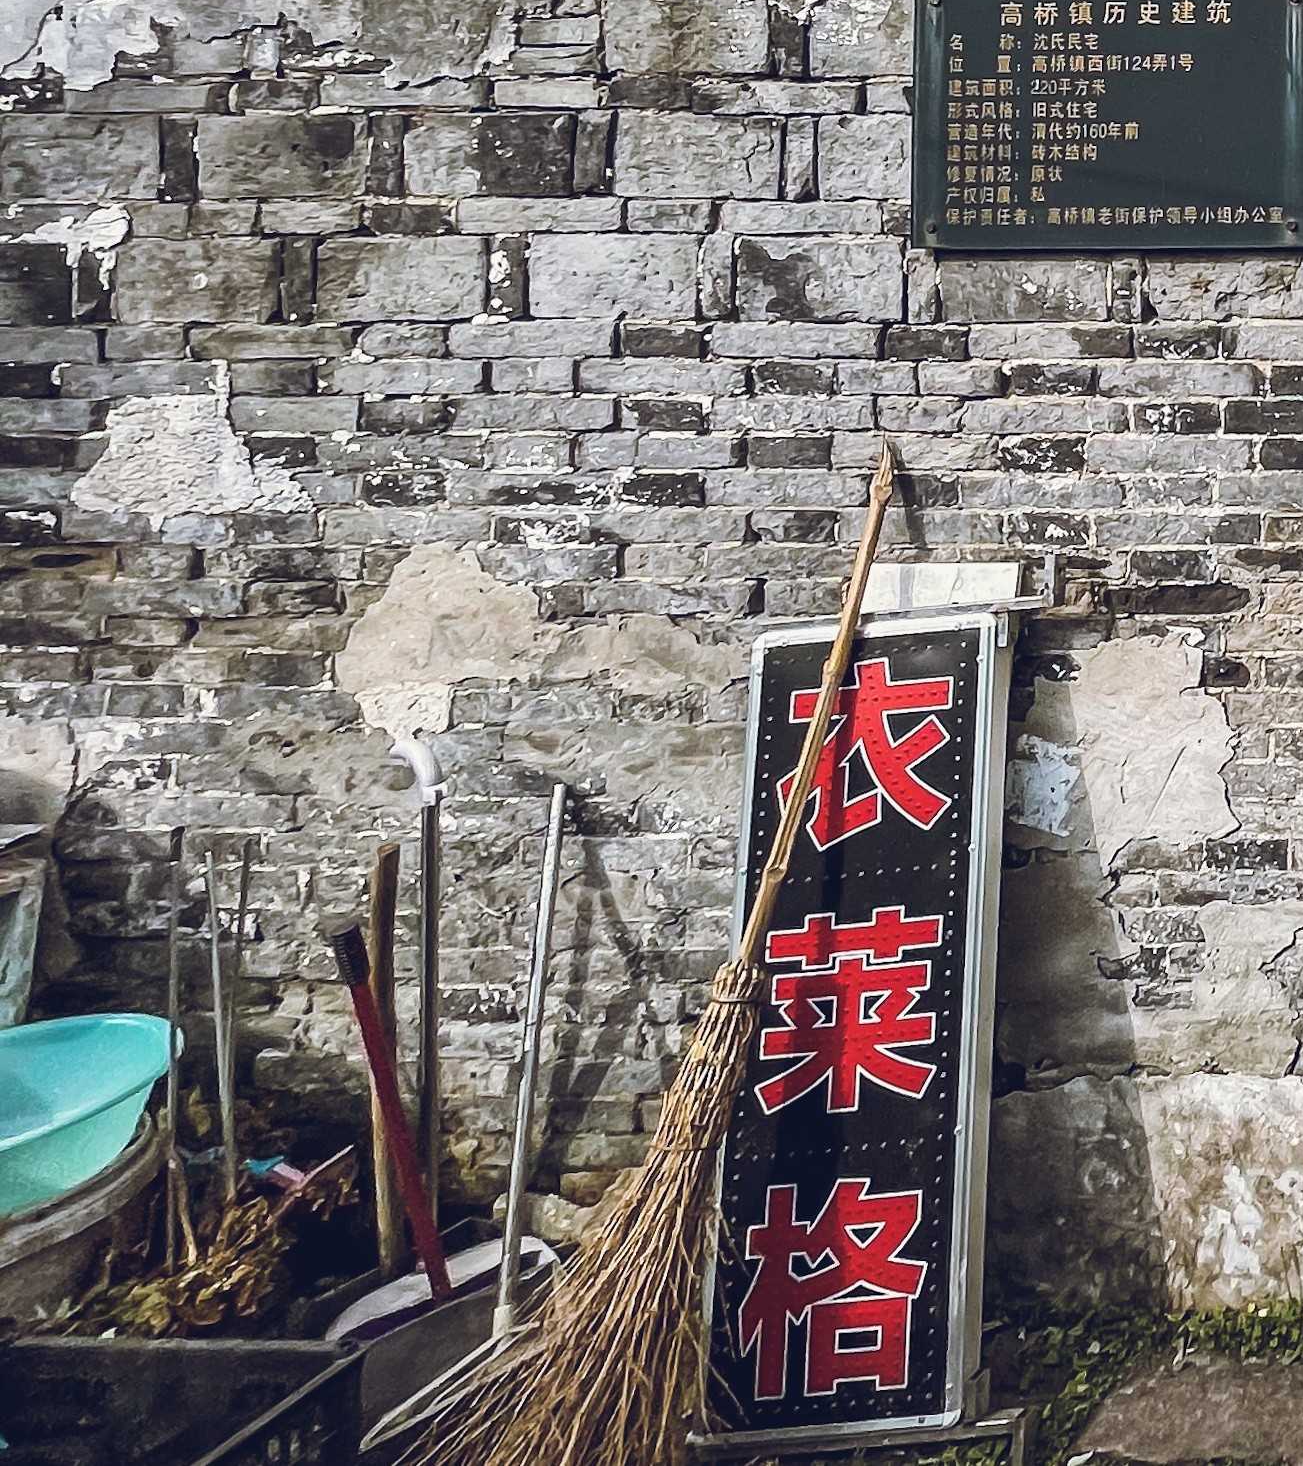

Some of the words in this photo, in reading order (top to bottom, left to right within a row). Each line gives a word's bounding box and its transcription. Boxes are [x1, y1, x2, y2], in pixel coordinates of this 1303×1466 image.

[1000, 0, 1232, 26] 高桥镇历史建筑
